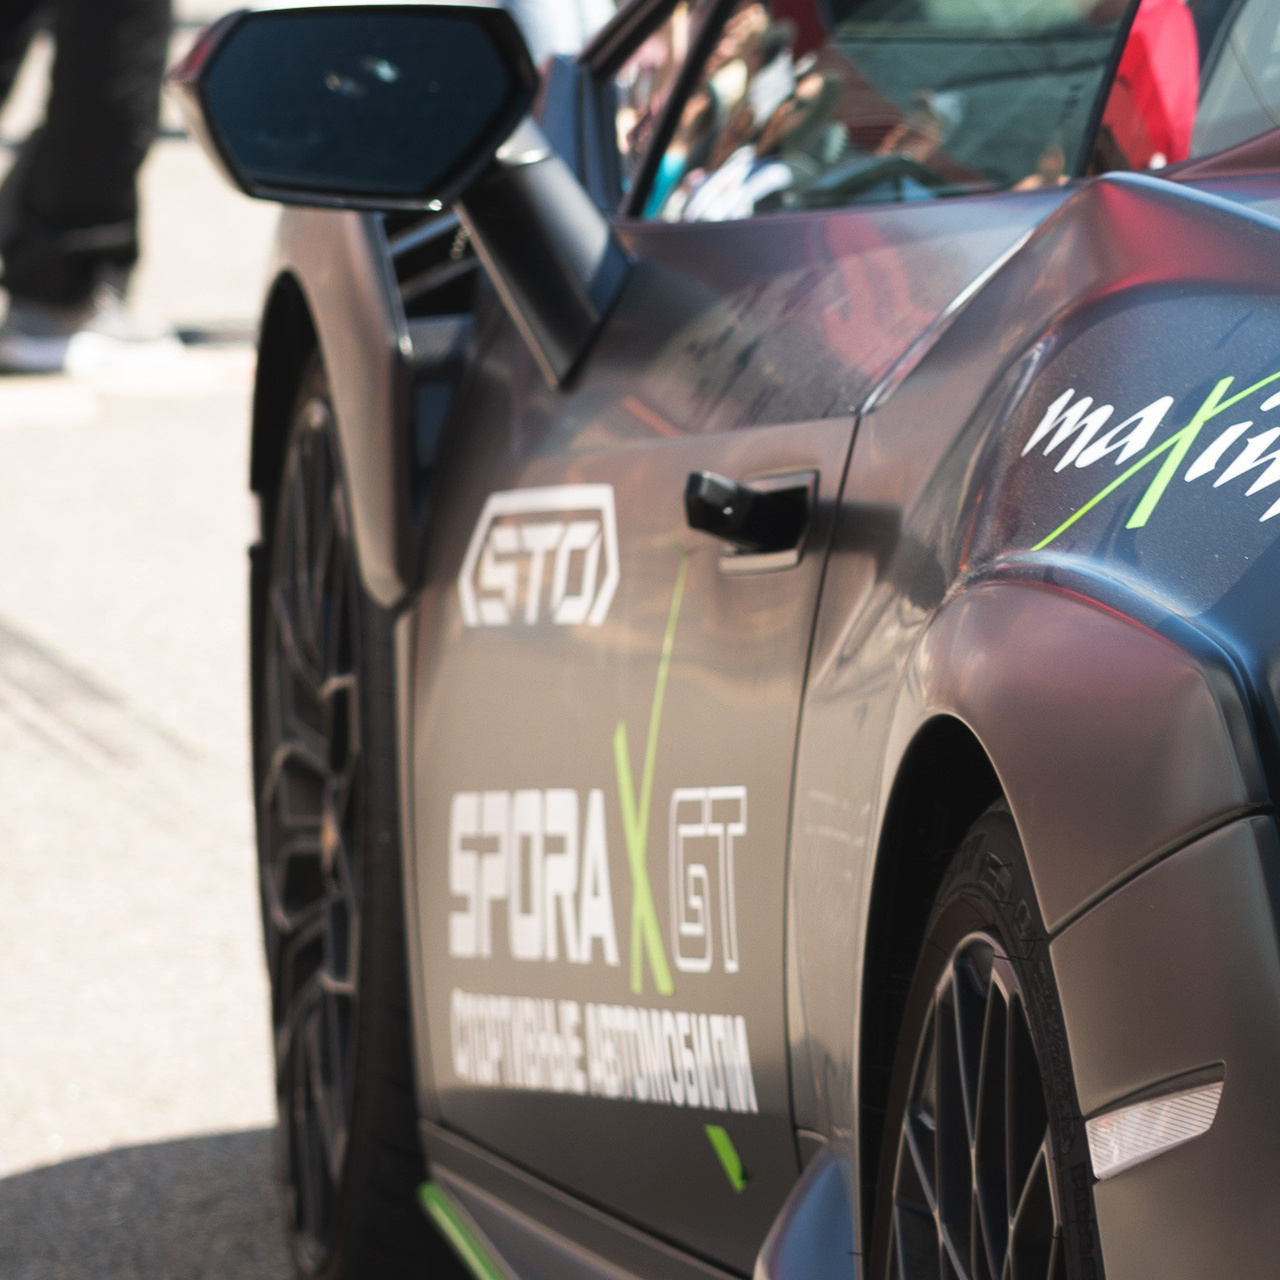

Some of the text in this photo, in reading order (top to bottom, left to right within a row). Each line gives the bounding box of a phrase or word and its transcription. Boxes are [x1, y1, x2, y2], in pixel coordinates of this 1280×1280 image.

[477, 519, 604, 627] STO
[669, 785, 747, 973] GT
[584, 1001, 759, 1115] АВТОМОБИЛИ
